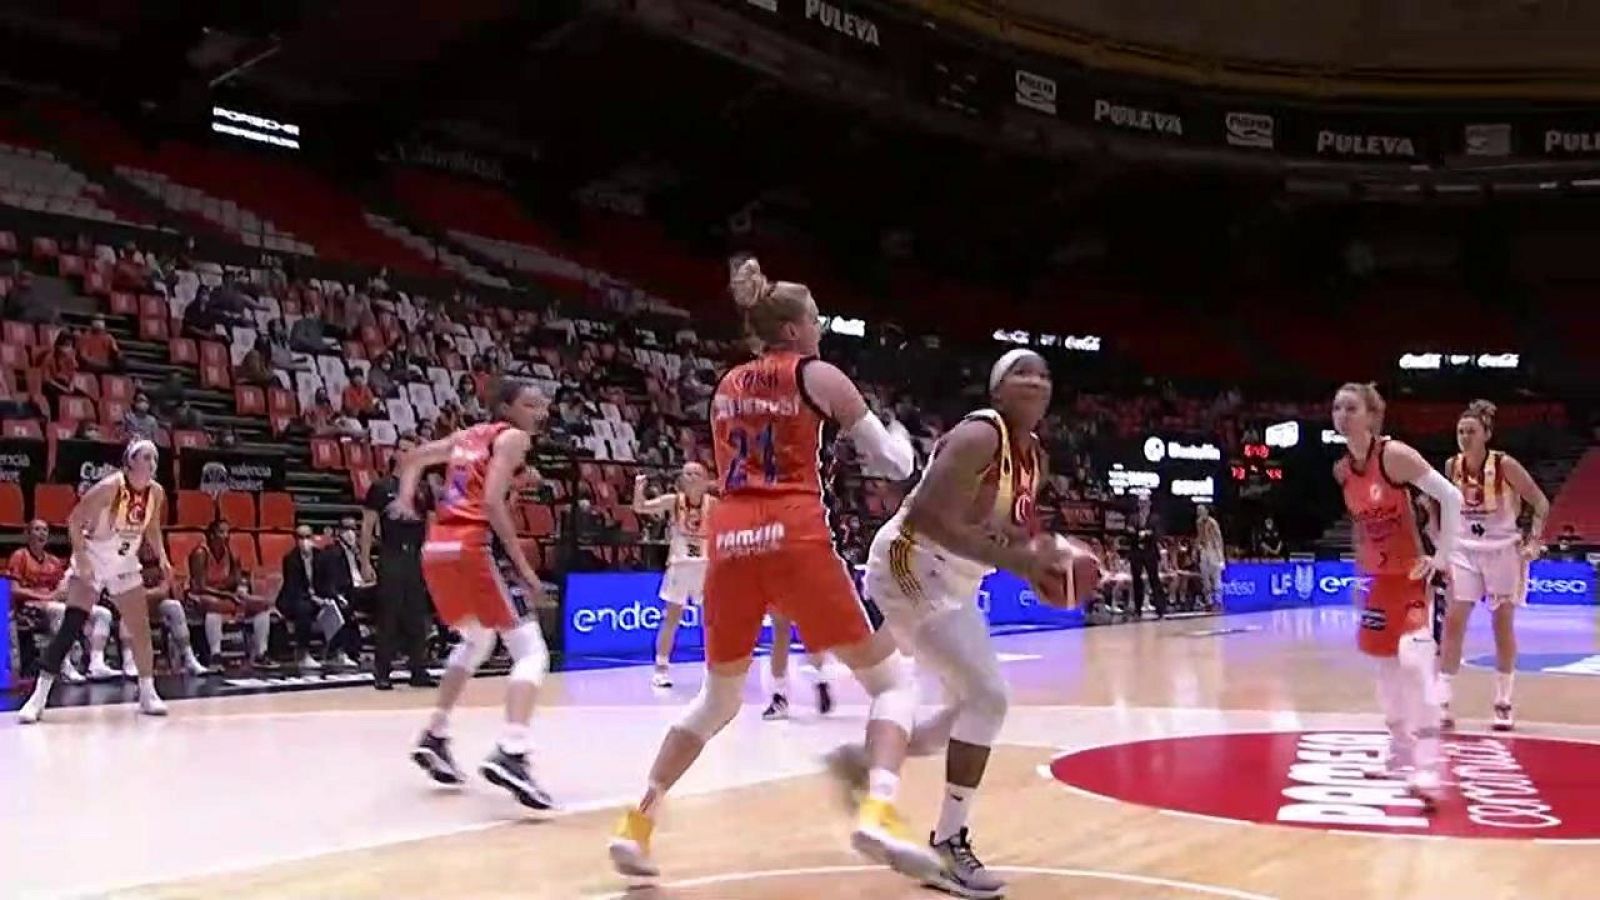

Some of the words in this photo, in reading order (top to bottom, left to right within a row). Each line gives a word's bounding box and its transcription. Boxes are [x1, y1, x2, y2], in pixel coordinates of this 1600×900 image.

[805, 0, 879, 46] PULEVA
[1094, 99, 1182, 135] PULEVA
[1317, 130, 1415, 156] PULEVA
[725, 424, 777, 489] 21
[572, 600, 700, 632] endea
